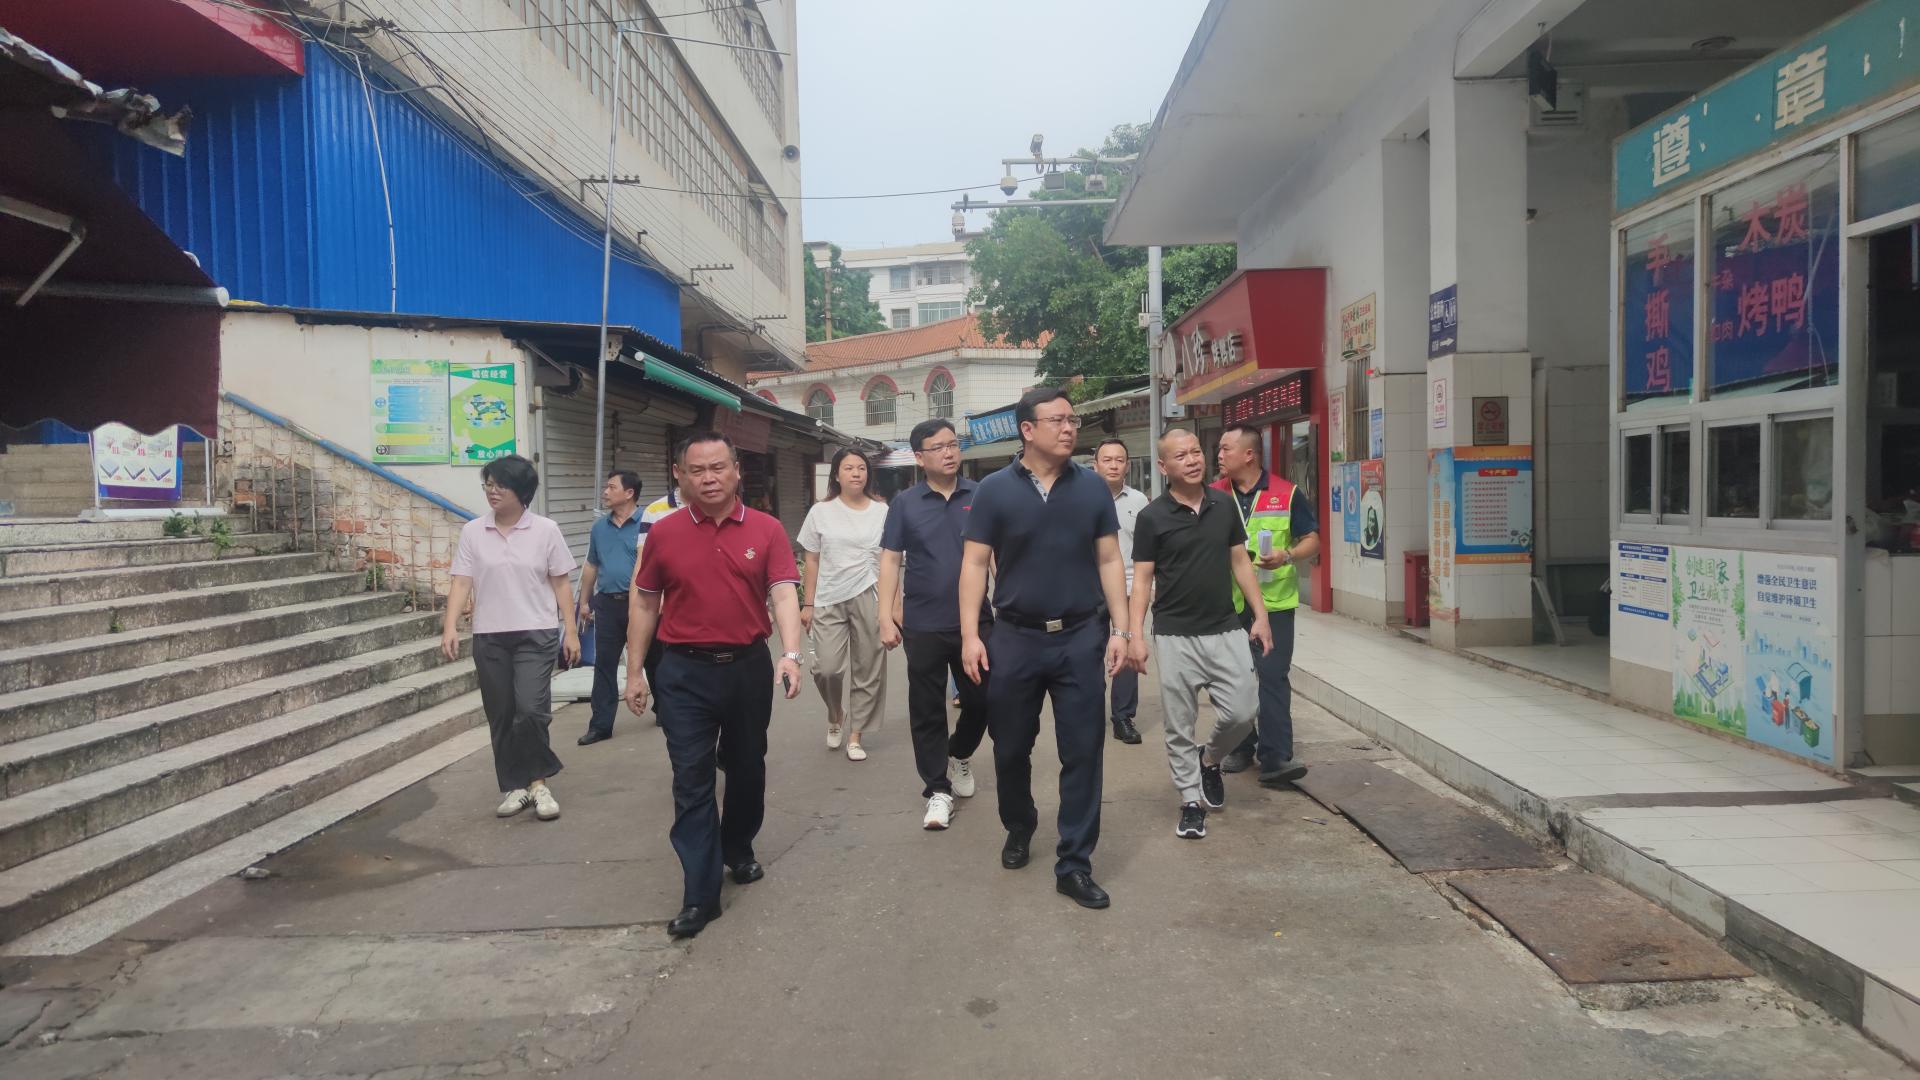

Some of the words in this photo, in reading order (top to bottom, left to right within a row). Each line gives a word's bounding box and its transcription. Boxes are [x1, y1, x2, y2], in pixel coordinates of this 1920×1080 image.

[1652, 114, 1690, 187] 遵
[1774, 45, 1828, 130] 章
[1740, 182, 1810, 252] 木炭
[1645, 232, 1671, 392] 手撕鸡
[1737, 273, 1806, 337] 烤鸭
[471, 369, 508, 379] 诚信经营
[1686, 556, 1730, 584] 创建国家
[1757, 574, 1817, 590] 增强全民卫生意识
[1687, 580, 1730, 604] 卫生城市
[1757, 591, 1816, 609] 自觉维护环境卫生
